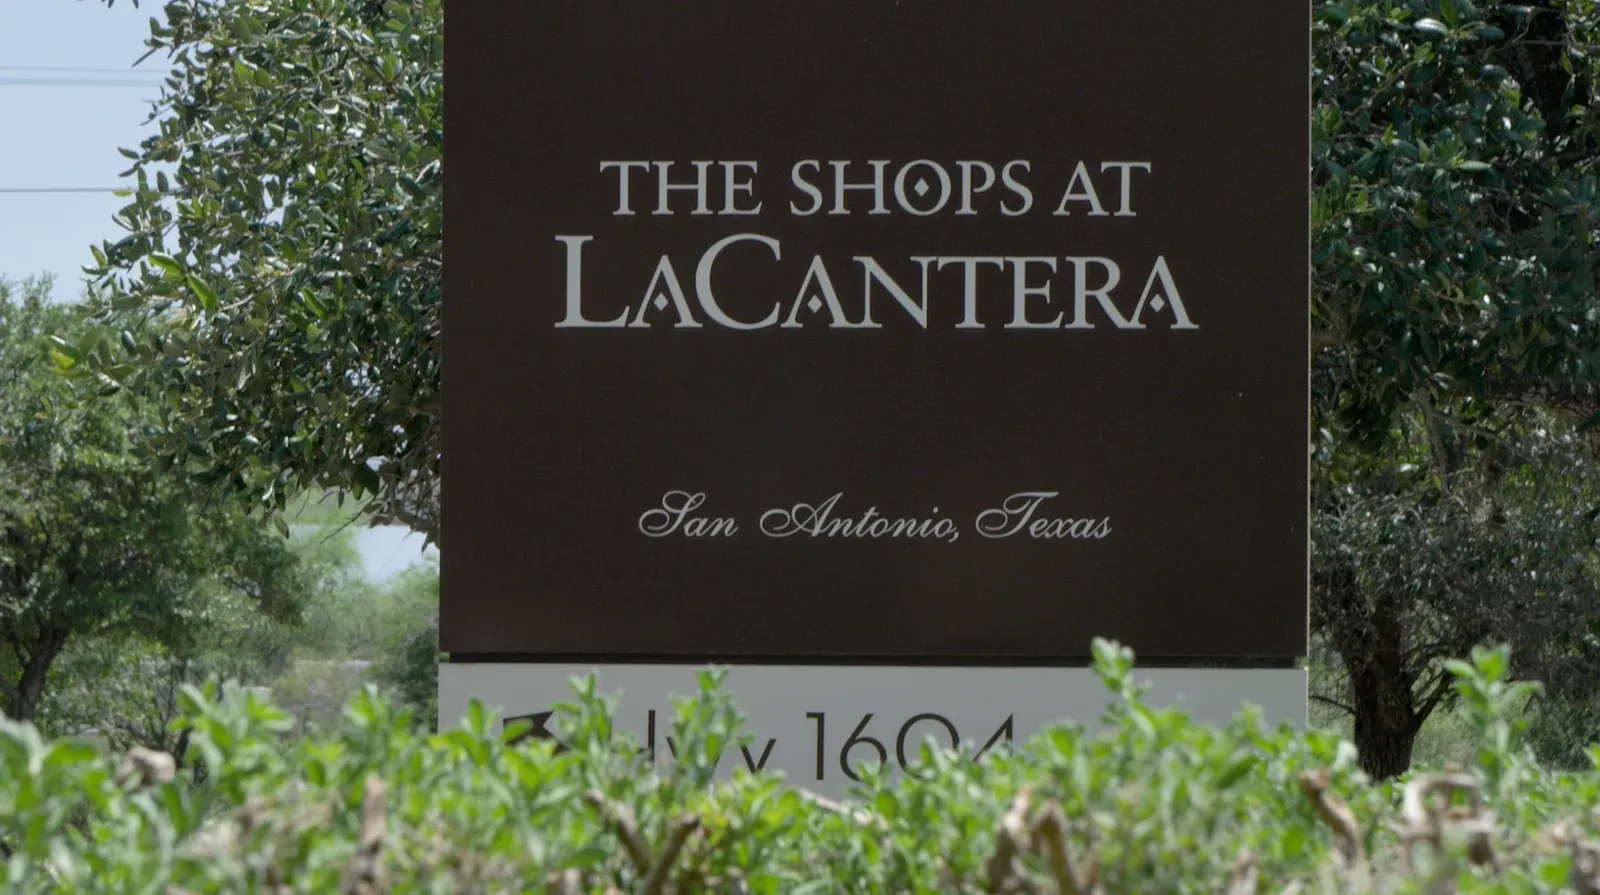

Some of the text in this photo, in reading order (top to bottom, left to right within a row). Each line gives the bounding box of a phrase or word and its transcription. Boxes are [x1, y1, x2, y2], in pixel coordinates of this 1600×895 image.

[599, 158, 1152, 217] THE SHOPS AT
[638, 489, 1112, 544] San Antonio, Texas
